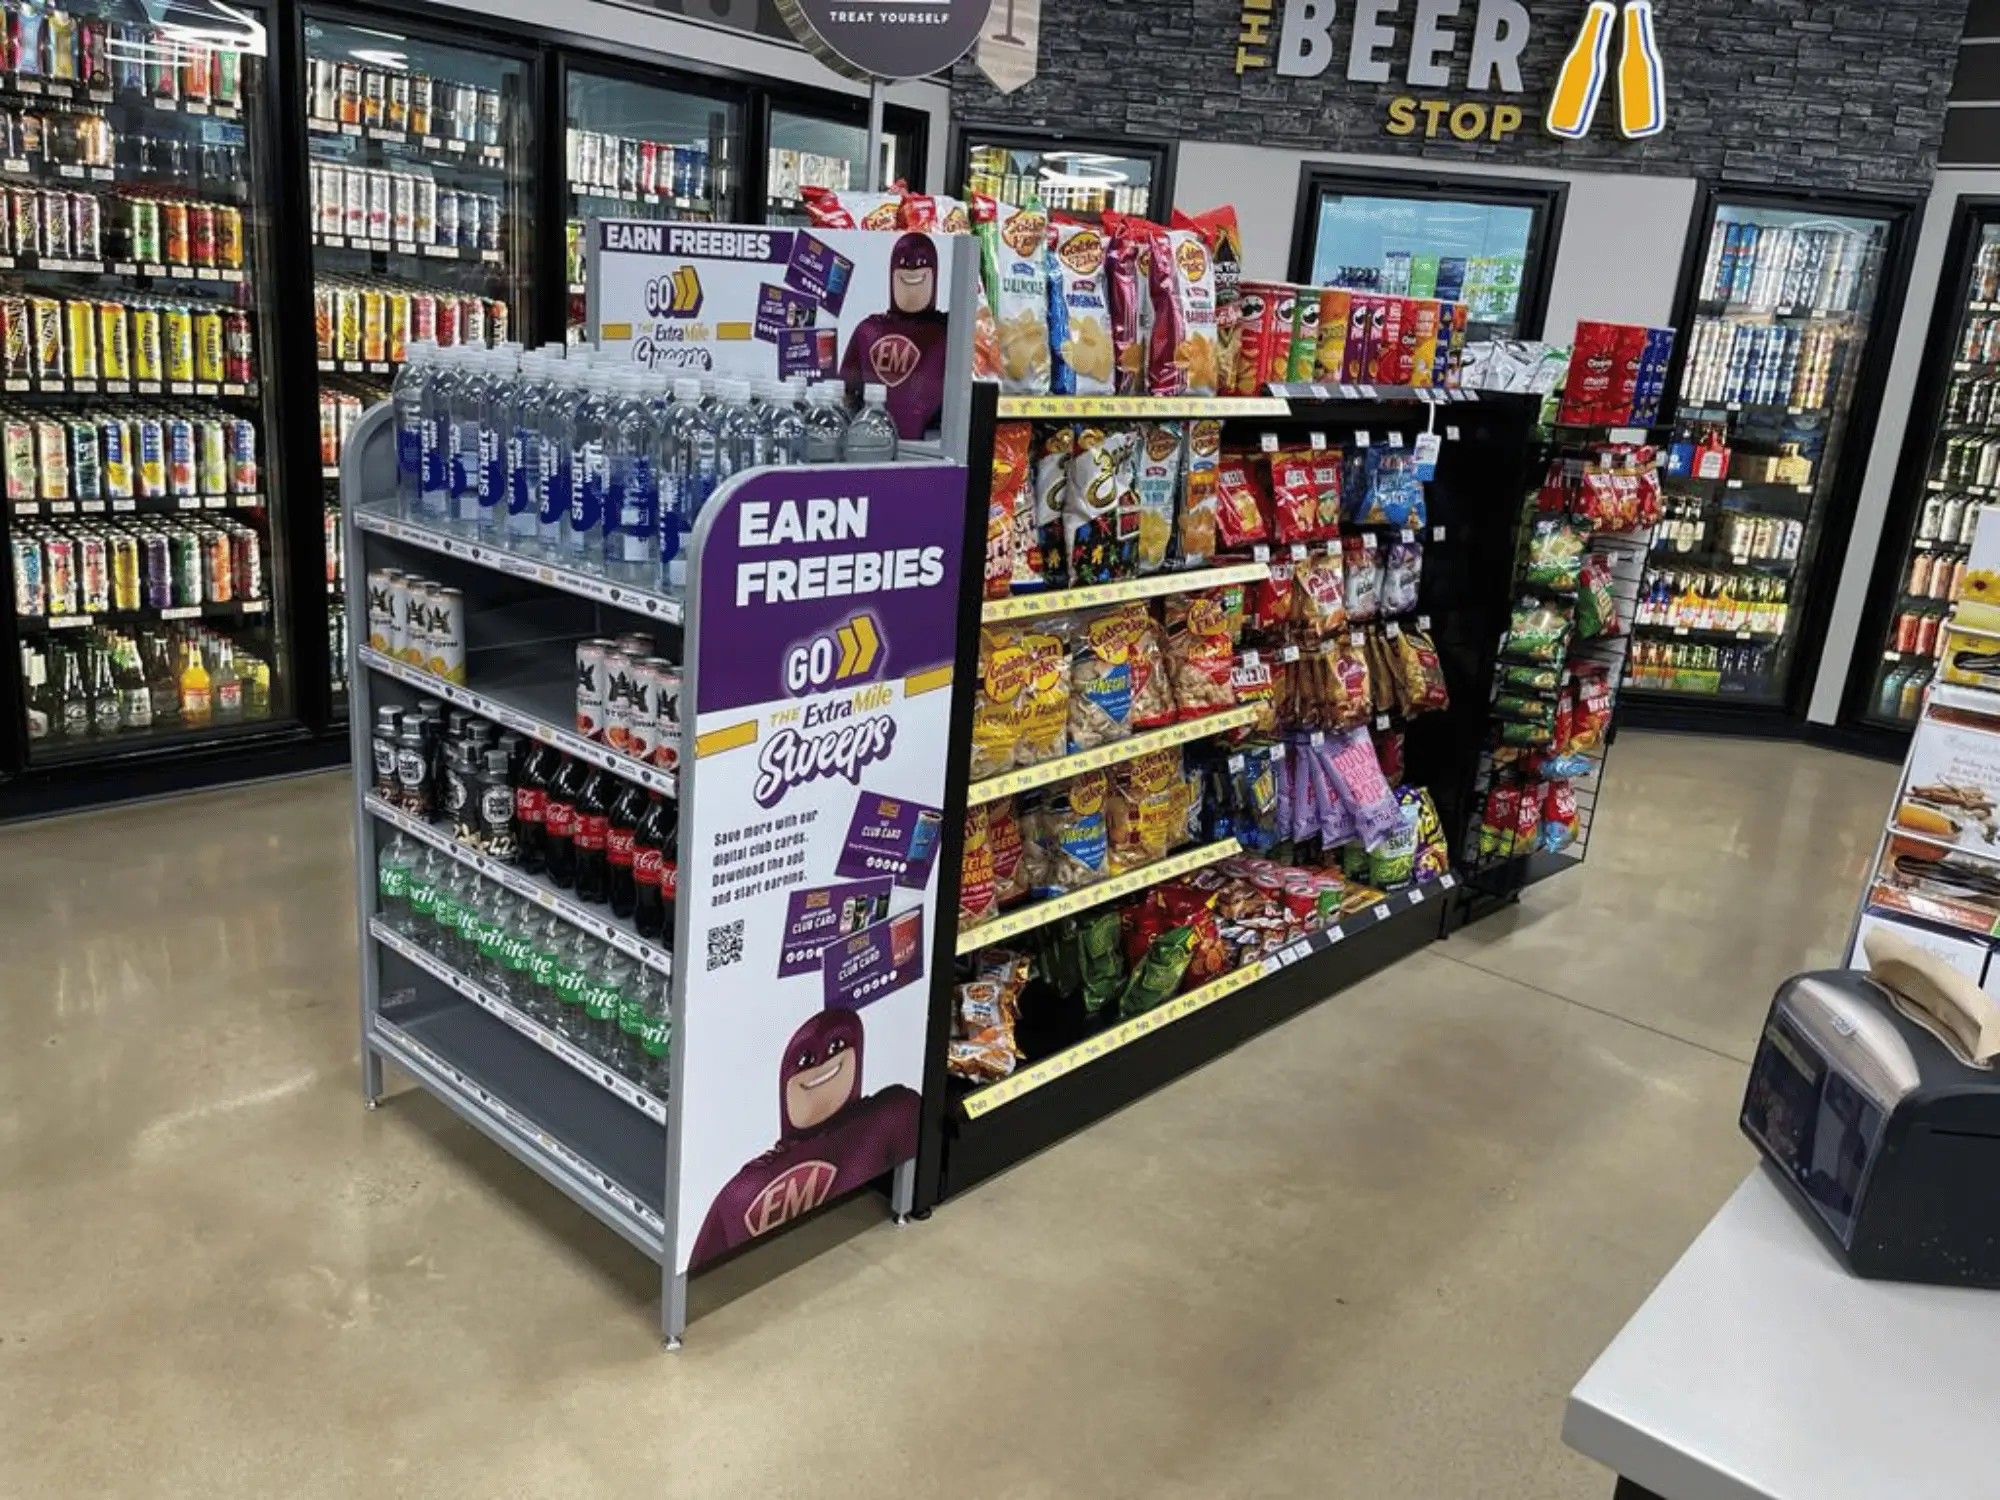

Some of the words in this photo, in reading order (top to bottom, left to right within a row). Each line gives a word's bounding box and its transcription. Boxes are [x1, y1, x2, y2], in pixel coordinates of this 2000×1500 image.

[828, 11, 874, 23] TREAT
[880, 12, 950, 24] YOURSELF
[1277, 0, 1531, 93] BEER
[1386, 97, 1523, 142] STOP
[606, 223, 662, 252] EARN
[669, 228, 771, 259] FREEBIES
[645, 274, 673, 312] GO
[876, 340, 911, 373] EM
[479, 429, 490, 497] smart
[571, 449, 584, 521] smart
[738, 496, 869, 547] EARN
[735, 545, 945, 607] FREEBIES
[787, 636, 834, 691] GO
[769, 707, 800, 727] THE
[753, 714, 897, 809] Sweeps
[714, 829, 741, 847] Save
[743, 821, 772, 839] more
[775, 814, 798, 831] with
[800, 809, 818, 825] our
[712, 846, 747, 867] digital
[749, 839, 772, 858] club
[712, 861, 765, 888] Download
[767, 856, 784, 872] the
[786, 848, 805, 866] app
[711, 890, 731, 907] and
[734, 881, 762, 901] start
[792, 919, 814, 935] CLUB
[814, 913, 837, 929] CARD
[759, 1166, 820, 1233] EM
